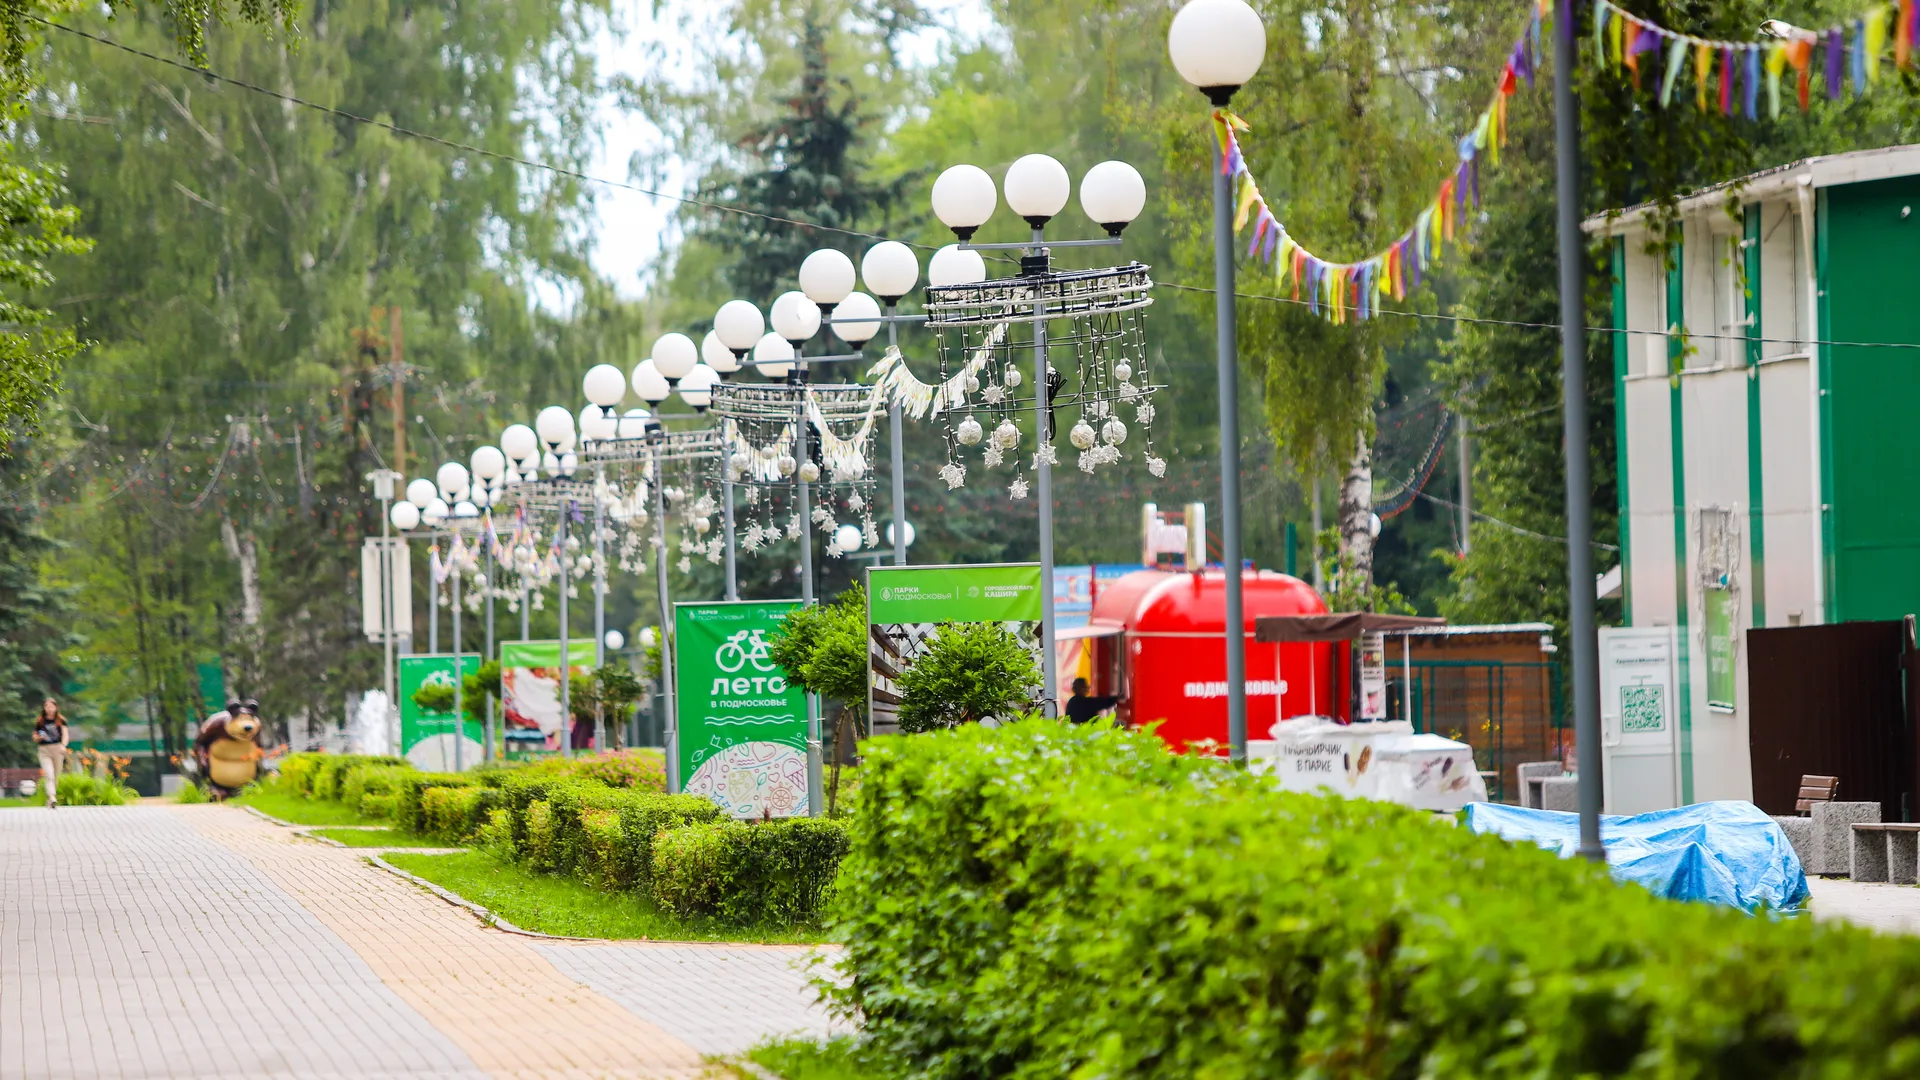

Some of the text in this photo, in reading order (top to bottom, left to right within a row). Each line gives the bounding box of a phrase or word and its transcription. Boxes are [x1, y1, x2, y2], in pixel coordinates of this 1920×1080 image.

[719, 699, 787, 709] ПОДМОСКОВЬЕ
[1297, 760, 1332, 772] В ПАРКЕ
